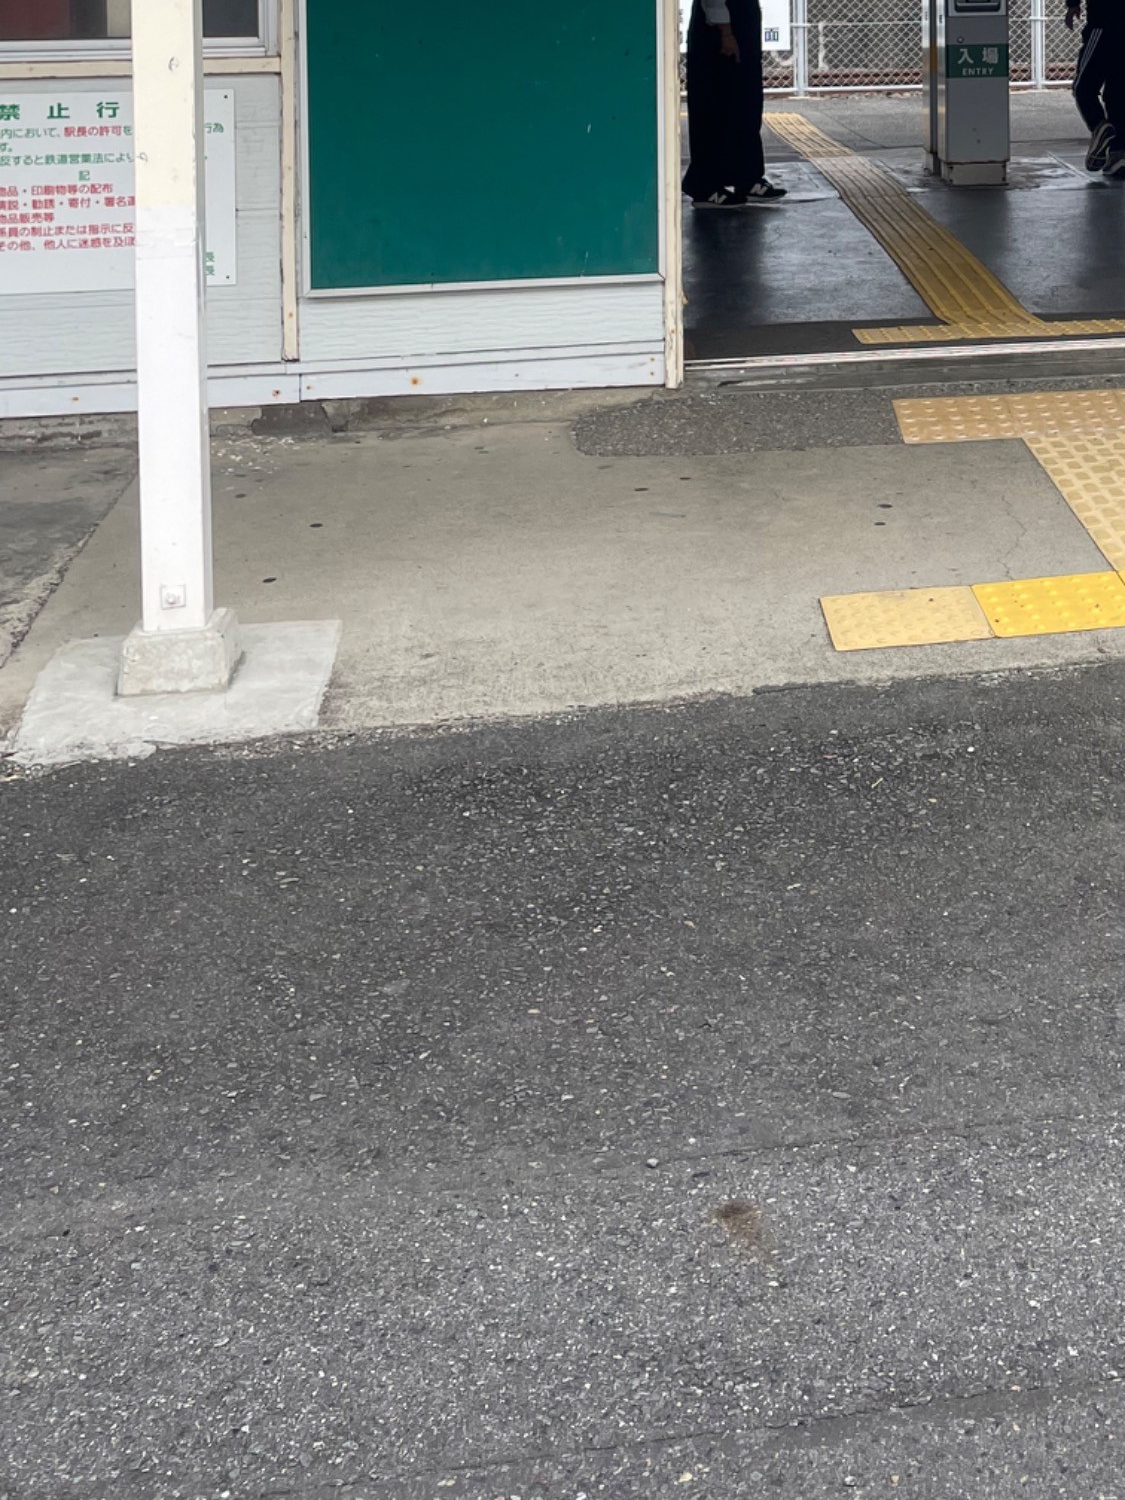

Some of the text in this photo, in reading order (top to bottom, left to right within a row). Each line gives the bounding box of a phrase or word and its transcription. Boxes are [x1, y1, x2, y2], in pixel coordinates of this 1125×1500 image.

[957, 47, 999, 65] 入場
[962, 67, 994, 76] ENTRY
[79, 170, 90, 181] 記
